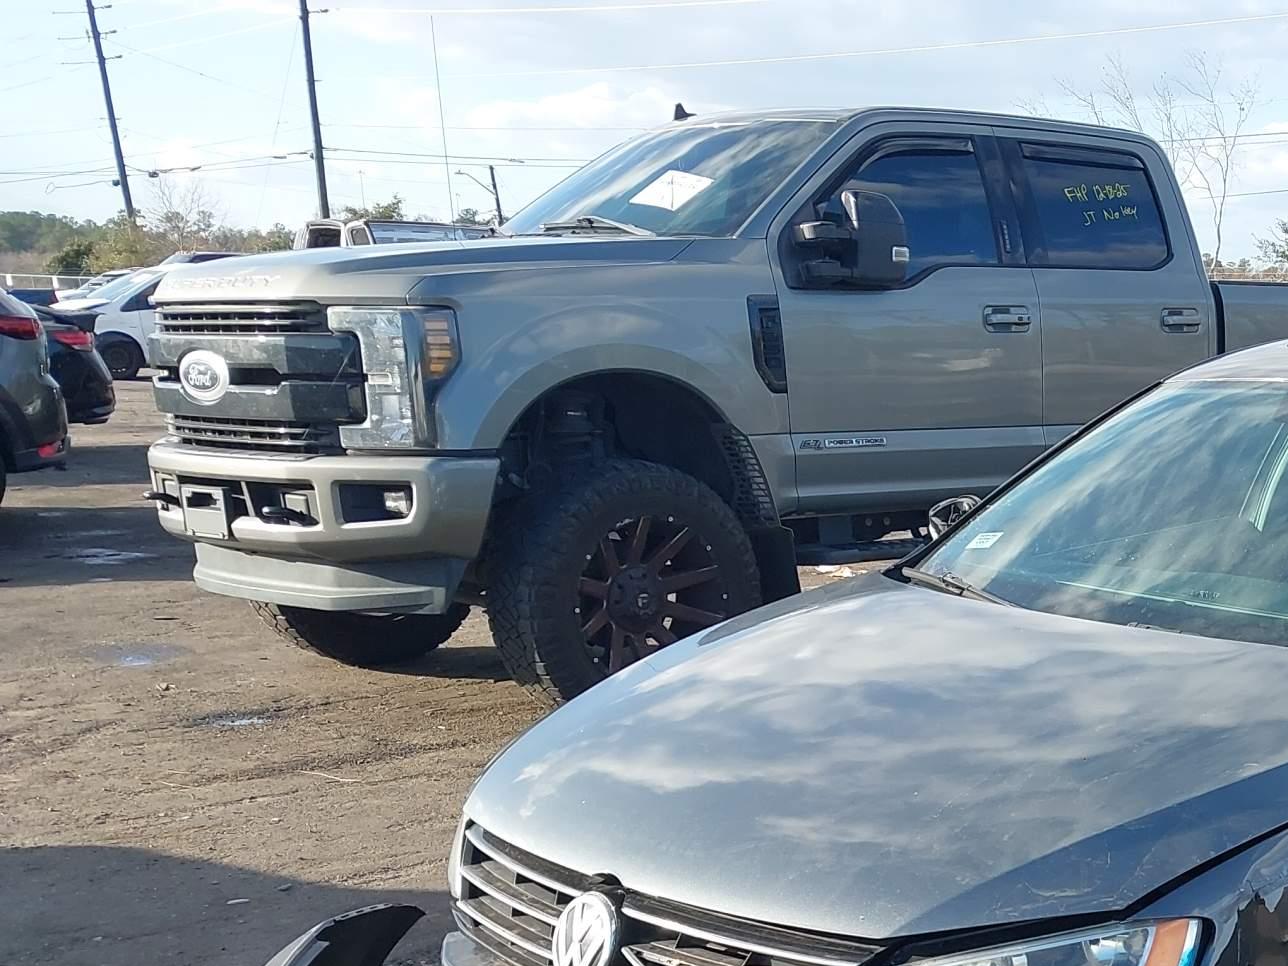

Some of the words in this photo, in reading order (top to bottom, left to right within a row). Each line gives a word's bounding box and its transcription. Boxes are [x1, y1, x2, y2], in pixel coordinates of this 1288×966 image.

[1064, 184, 1088, 202] FHP
[1083, 211, 1096, 226] JT
[1103, 208, 1120, 221] No
[189, 364, 211, 386] Ford
